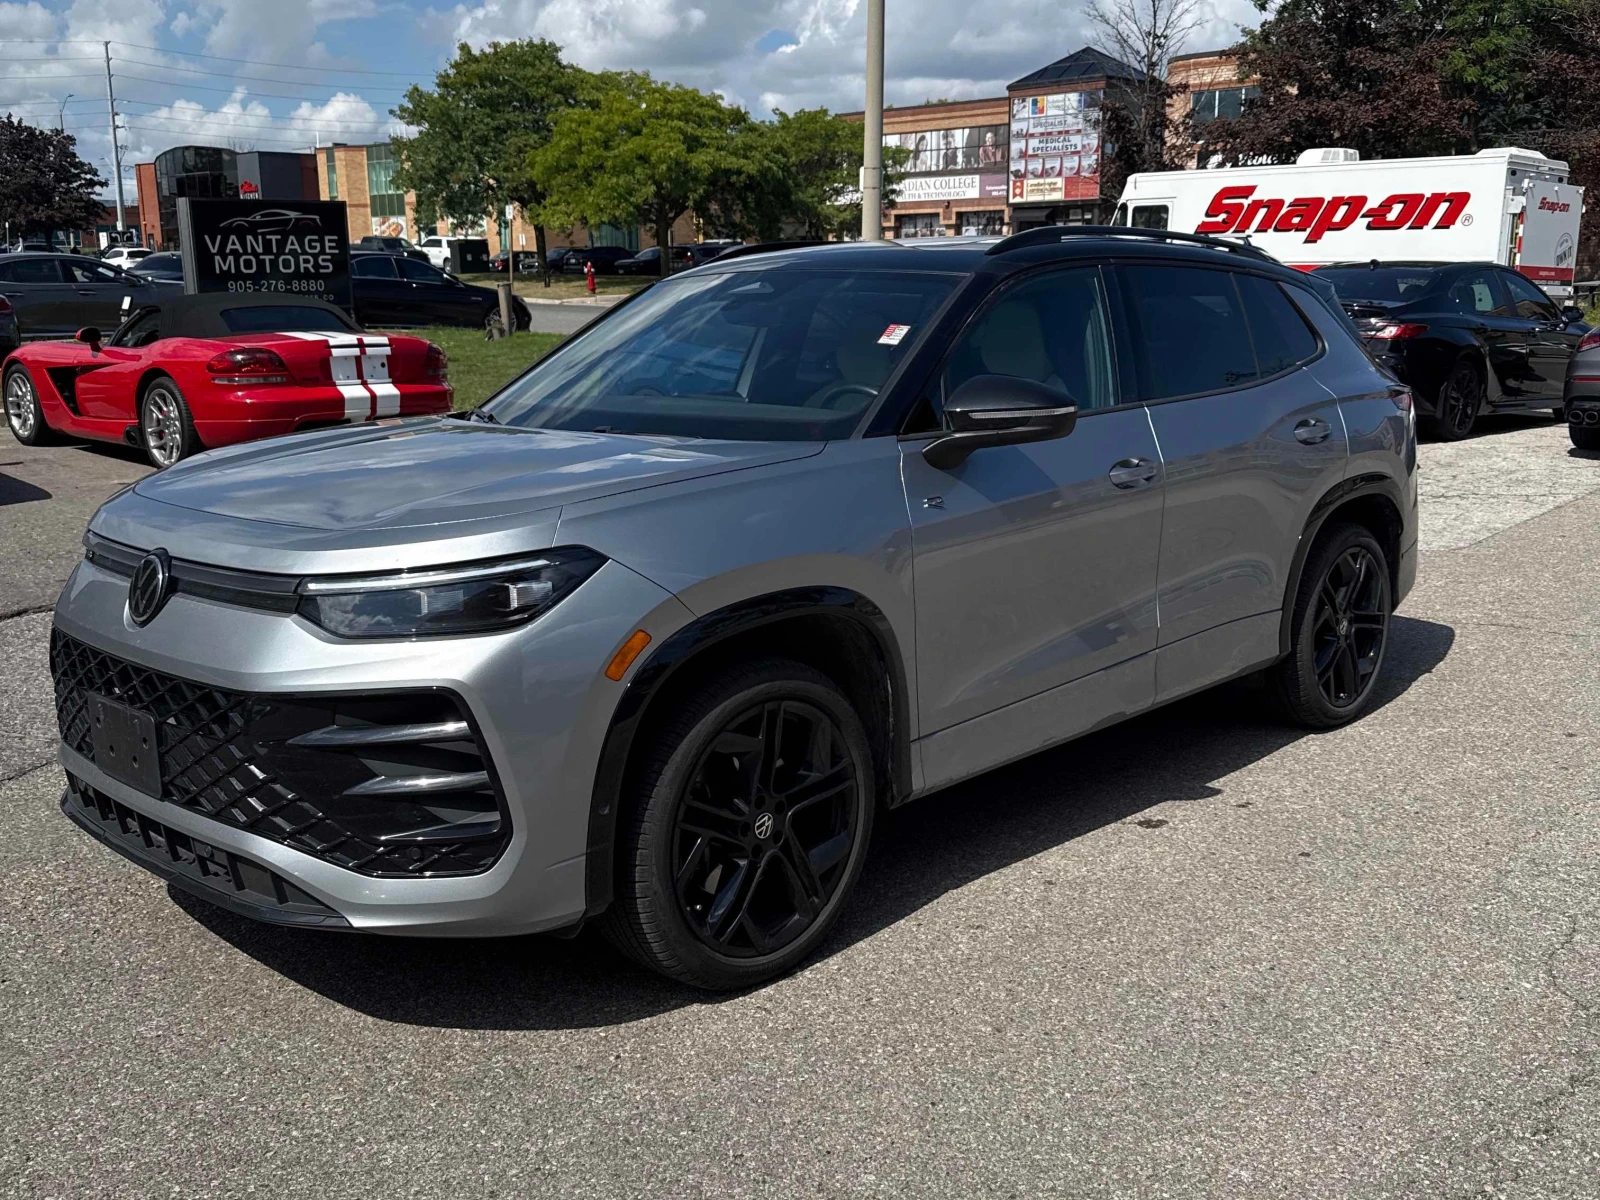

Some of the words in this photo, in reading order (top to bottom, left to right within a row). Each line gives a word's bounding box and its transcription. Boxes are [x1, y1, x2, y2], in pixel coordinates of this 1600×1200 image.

[1038, 136, 1071, 145] MEDICAL
[1032, 143, 1078, 153] SPECIALISTS
[902, 179, 931, 192] ADIAN
[933, 176, 977, 191] COLLEGE
[923, 190, 967, 199] TECHNOLOGY
[1538, 196, 1571, 214] Snap-on
[203, 234, 340, 254] VANTAGE
[213, 255, 334, 274] MOTORS
[227, 280, 326, 293] 905-276-8880
